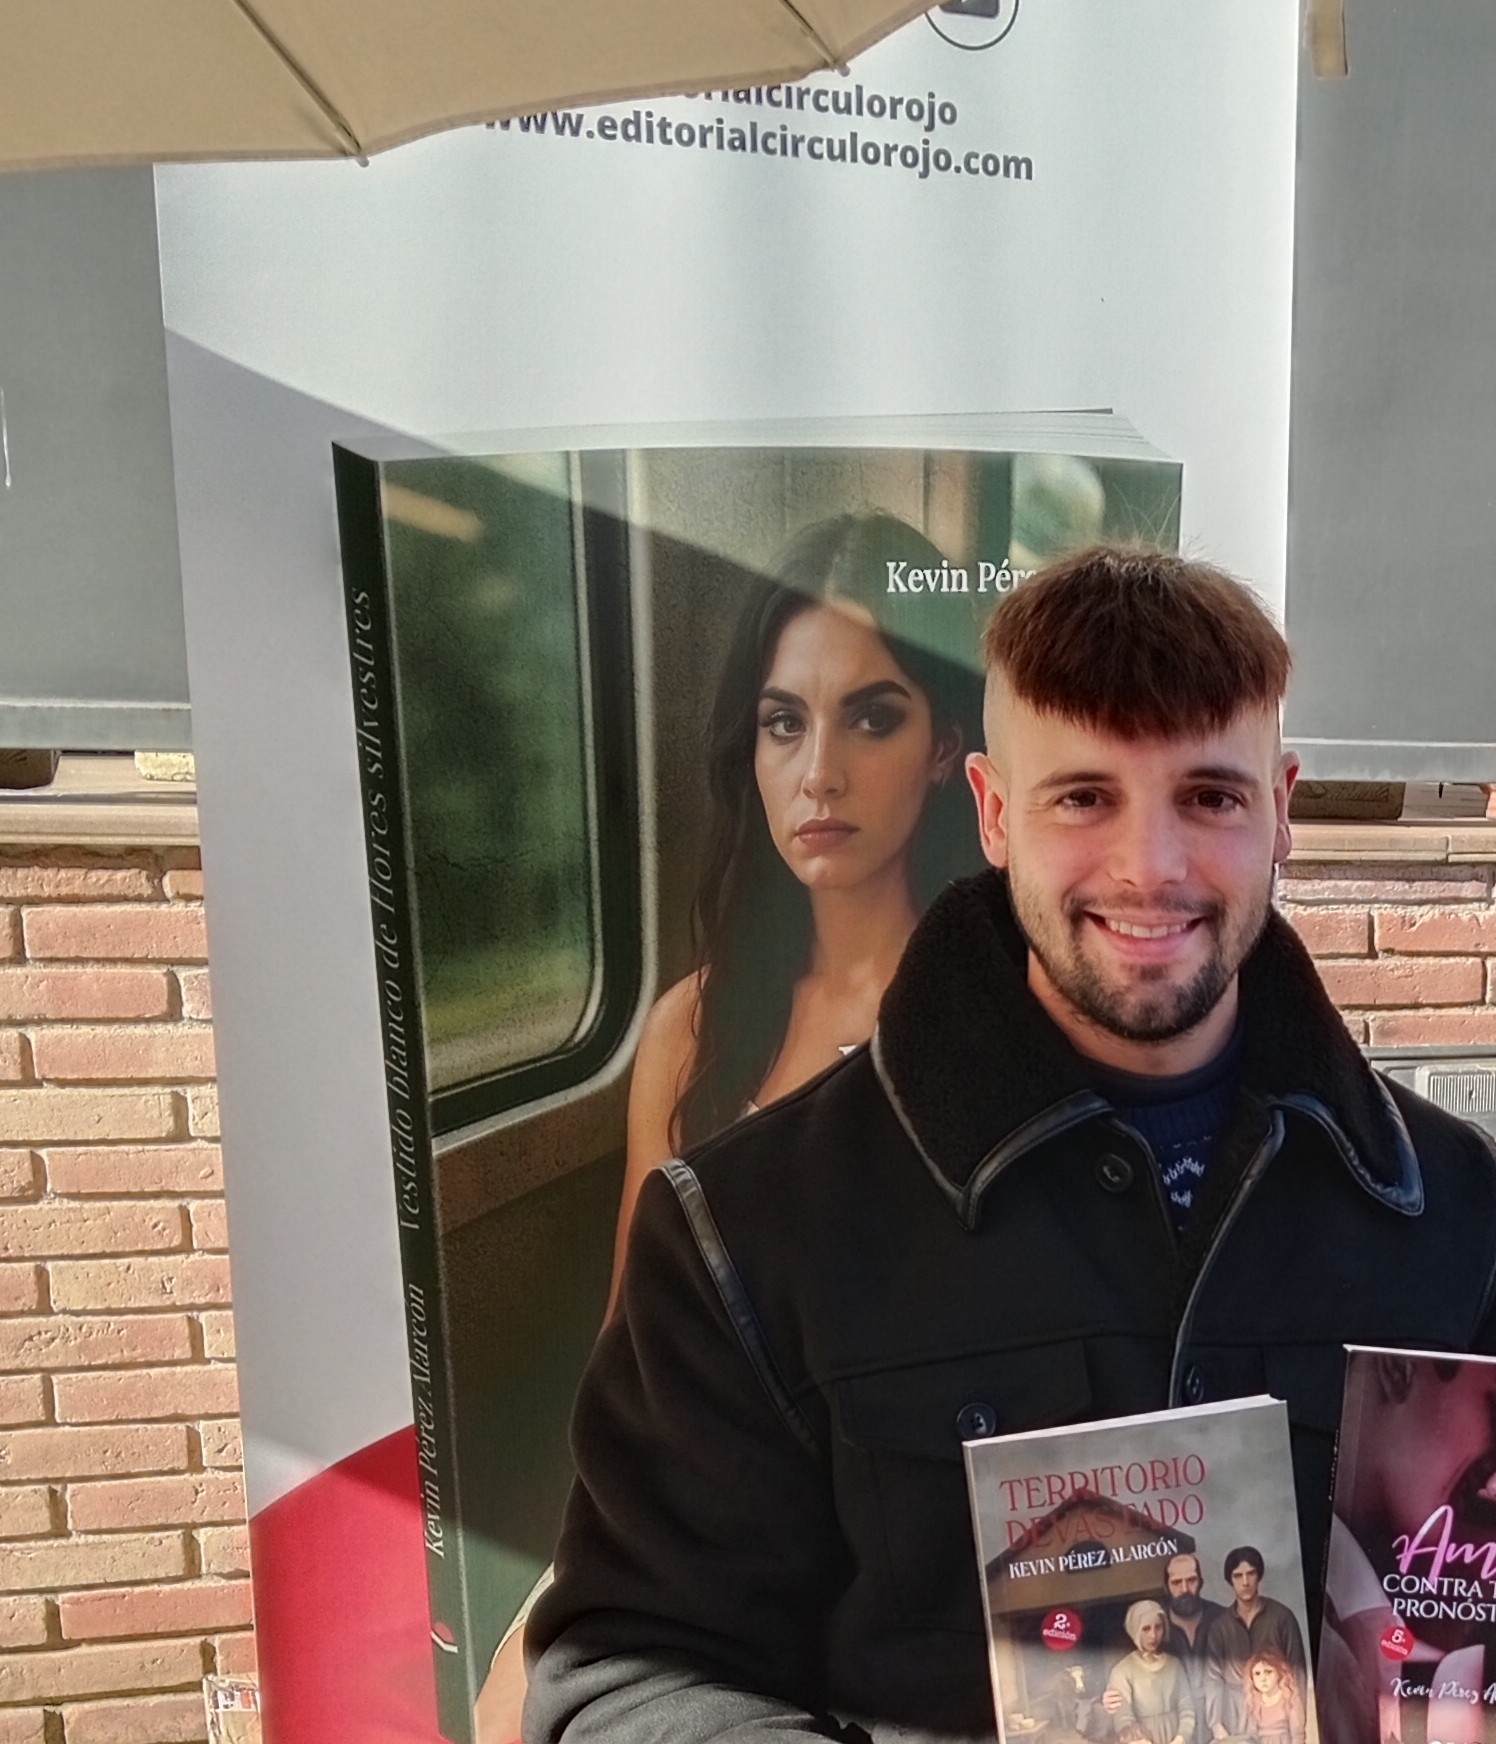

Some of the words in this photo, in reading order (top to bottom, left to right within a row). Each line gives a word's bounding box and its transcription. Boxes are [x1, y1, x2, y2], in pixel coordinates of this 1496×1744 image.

[885, 559, 969, 593] Kevin
[349, 586, 386, 780] silvestres
[377, 927, 400, 971] de
[382, 979, 411, 1105] blanco
[391, 1107, 421, 1234] Vestido
[405, 1283, 434, 1398] Alarcón
[415, 1394, 440, 1485] Pérez
[999, 1454, 1206, 1512] TERRITORIO
[423, 1480, 445, 1559] Kevin
[1009, 1557, 1056, 1579] KEVIN
[1059, 1549, 1106, 1571] PÉREZ
[1109, 1536, 1178, 1564] ALARCÓN
[1383, 1573, 1483, 1598] CONTRA
[1390, 1677, 1434, 1698] Kevin
